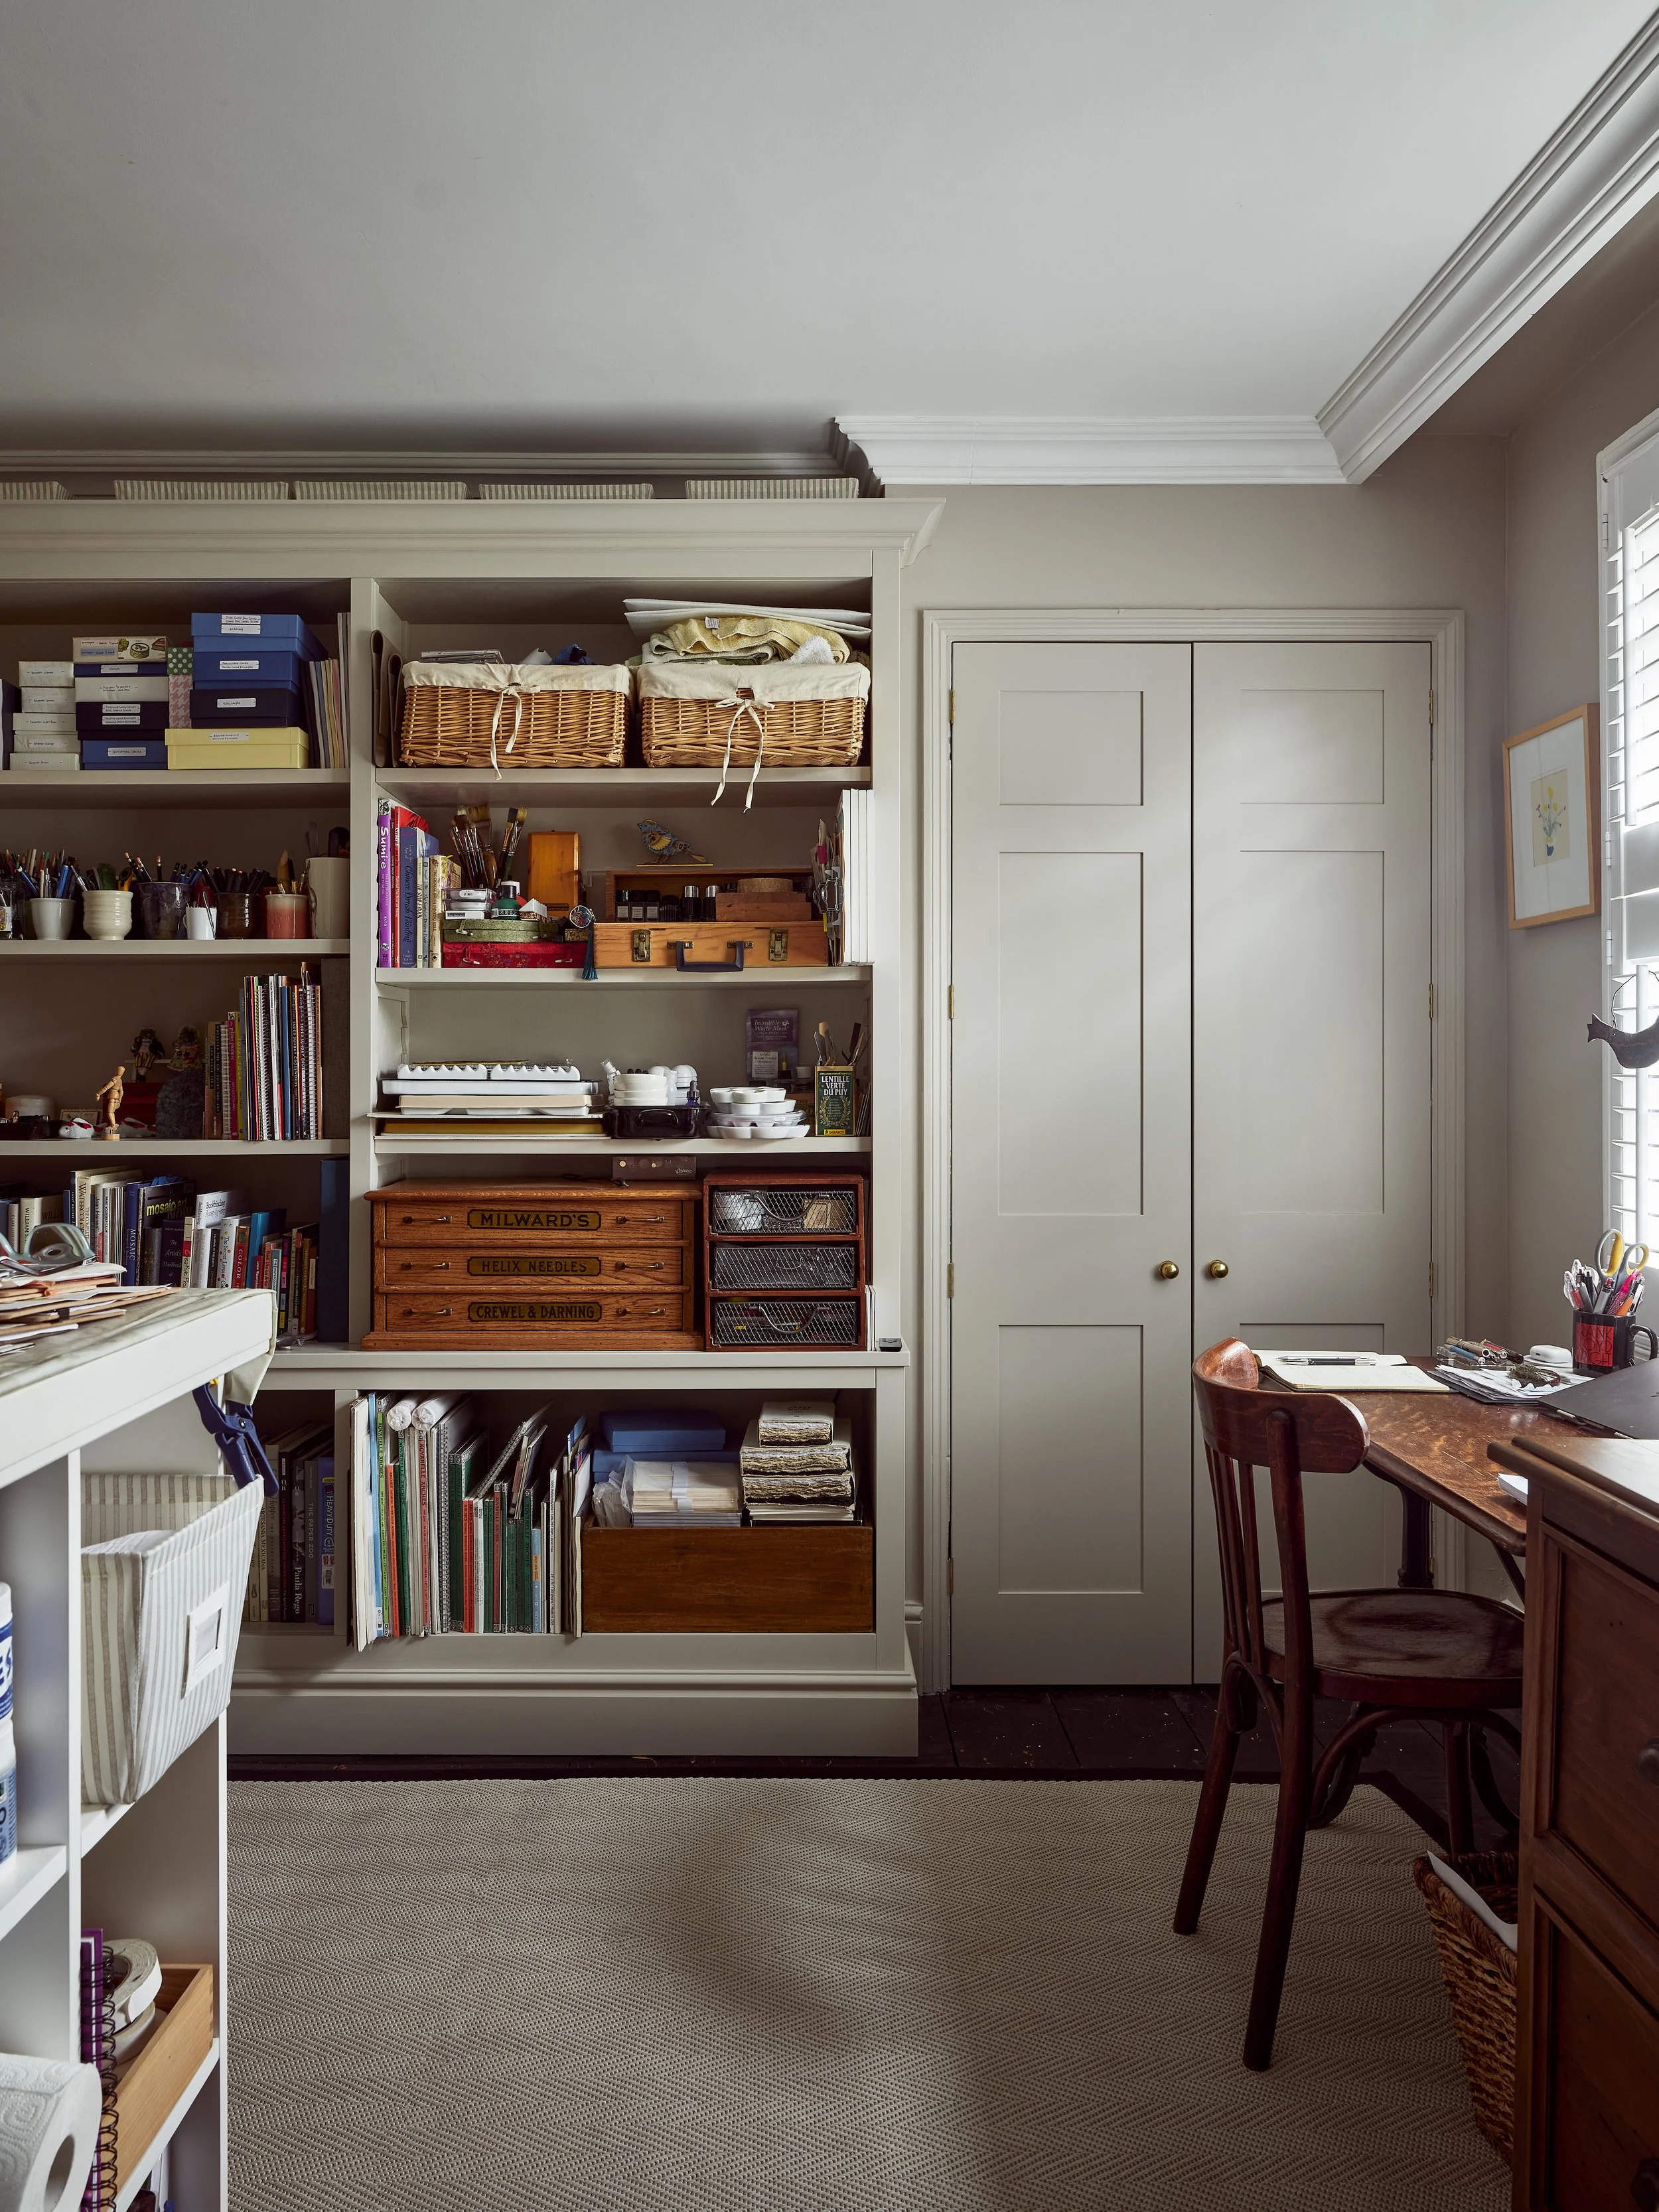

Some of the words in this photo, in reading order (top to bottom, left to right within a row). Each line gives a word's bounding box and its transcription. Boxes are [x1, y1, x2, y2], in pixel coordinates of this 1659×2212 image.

[380, 826, 390, 869] Sumi-e
[403, 865, 413, 889] Chinese
[403, 892, 413, 913] Brush
[403, 915, 413, 943] Painting
[146, 1199, 177, 1217] mosaic
[480, 1213, 590, 1228] MILWARD'S
[482, 1260, 521, 1273] HELIX
[528, 1260, 587, 1273] NEEDLES
[476, 1305, 526, 1319] CREWEL
[528, 1305, 537, 1319] &
[540, 1305, 595, 1319] DARNING
[1577, 1323, 1613, 1341] RANK
[267, 1497, 277, 1519] Hopper
[293, 1592, 302, 1615] Rego
